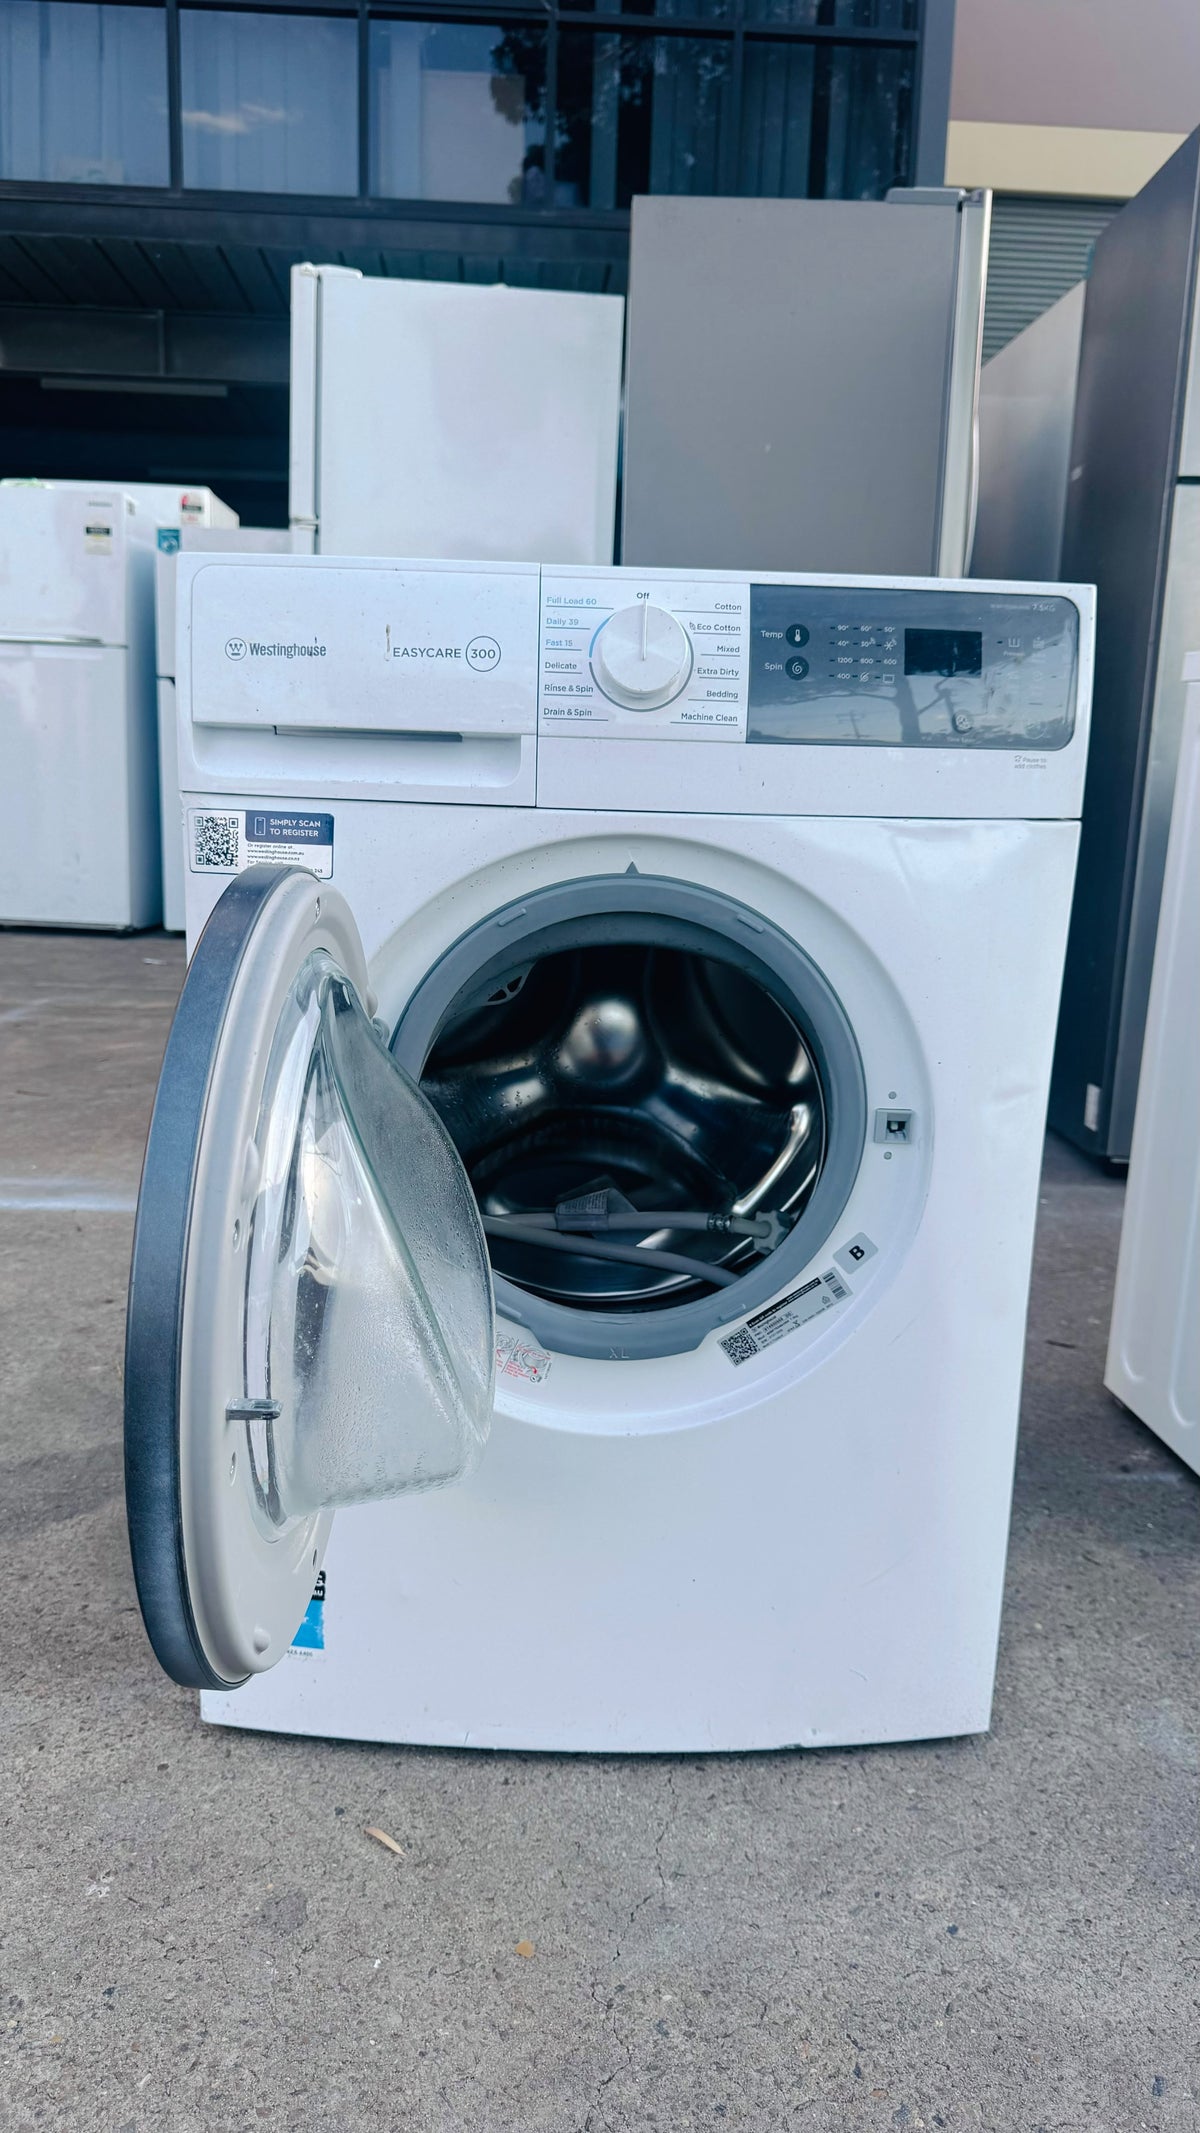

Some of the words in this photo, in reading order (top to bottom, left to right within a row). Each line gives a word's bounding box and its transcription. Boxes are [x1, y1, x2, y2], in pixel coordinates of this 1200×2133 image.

[546, 597, 562, 605] Full
[564, 597, 584, 605] Load
[714, 603, 742, 611] Cotton
[546, 617, 567, 627] Daily
[697, 623, 711, 631] Eco
[714, 624, 741, 632] Cotton
[761, 630, 784, 639] Temp
[545, 639, 563, 647] Fast
[249, 643, 327, 659] Westinghouse
[393, 647, 462, 659] EASYCARE
[471, 649, 496, 660] 300
[717, 645, 740, 653] Mixed
[544, 662, 577, 670] Delicate
[764, 662, 783, 672] Spin
[697, 667, 718, 675] Extra
[720, 668, 739, 677] Dirty
[544, 684, 567, 692] Rinse
[568, 685, 574, 693] &
[575, 685, 594, 694] Spin
[706, 690, 739, 699] Bedding
[543, 708, 565, 716] Drain
[566, 708, 572, 716] &
[574, 708, 592, 718] Spin
[681, 713, 714, 721] Machine
[715, 714, 738, 722] Clean
[270, 819, 297, 827] SIMPLY
[299, 820, 321, 828] SCAN
[270, 828, 280, 836] TO
[282, 829, 319, 837] REGISTER
[849, 1245, 865, 1261] B
